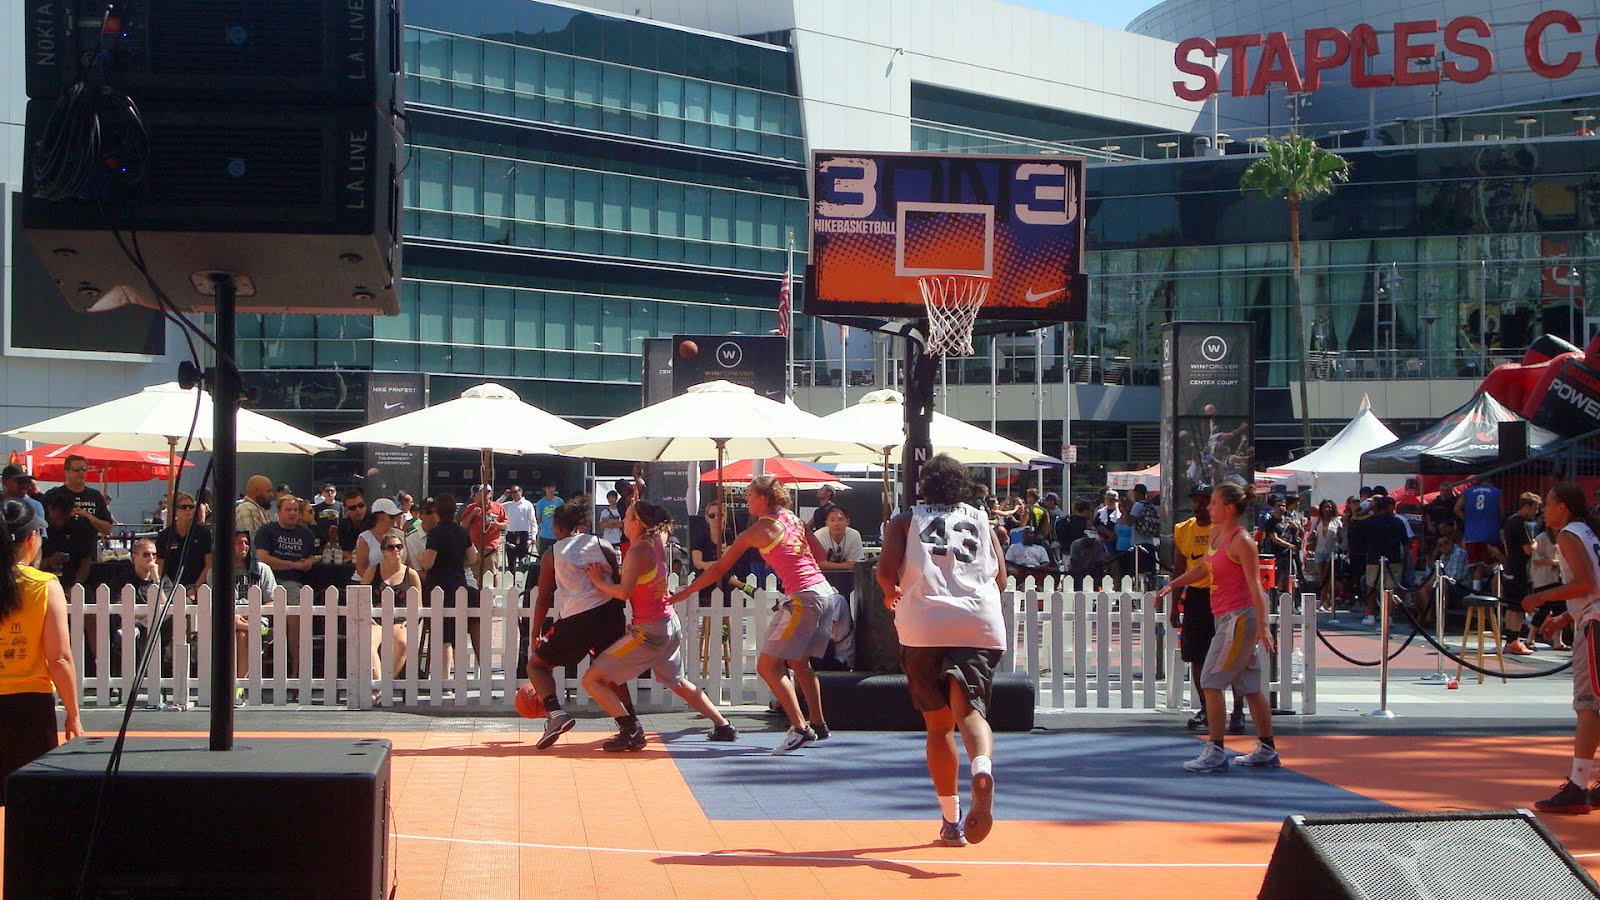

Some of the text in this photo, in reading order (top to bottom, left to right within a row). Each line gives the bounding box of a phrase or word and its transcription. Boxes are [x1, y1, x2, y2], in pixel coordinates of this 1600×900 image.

[36, 3, 55, 66] NOKIA
[349, 0, 366, 42] LIVE
[1172, 10, 1600, 101] STAPLES C
[348, 128, 367, 171] LIVE
[814, 219, 897, 235] NIKEBASKETBALL
[1548, 378, 1600, 420] POWE
[1476, 494, 1486, 510] 8
[919, 516, 980, 563] 43
